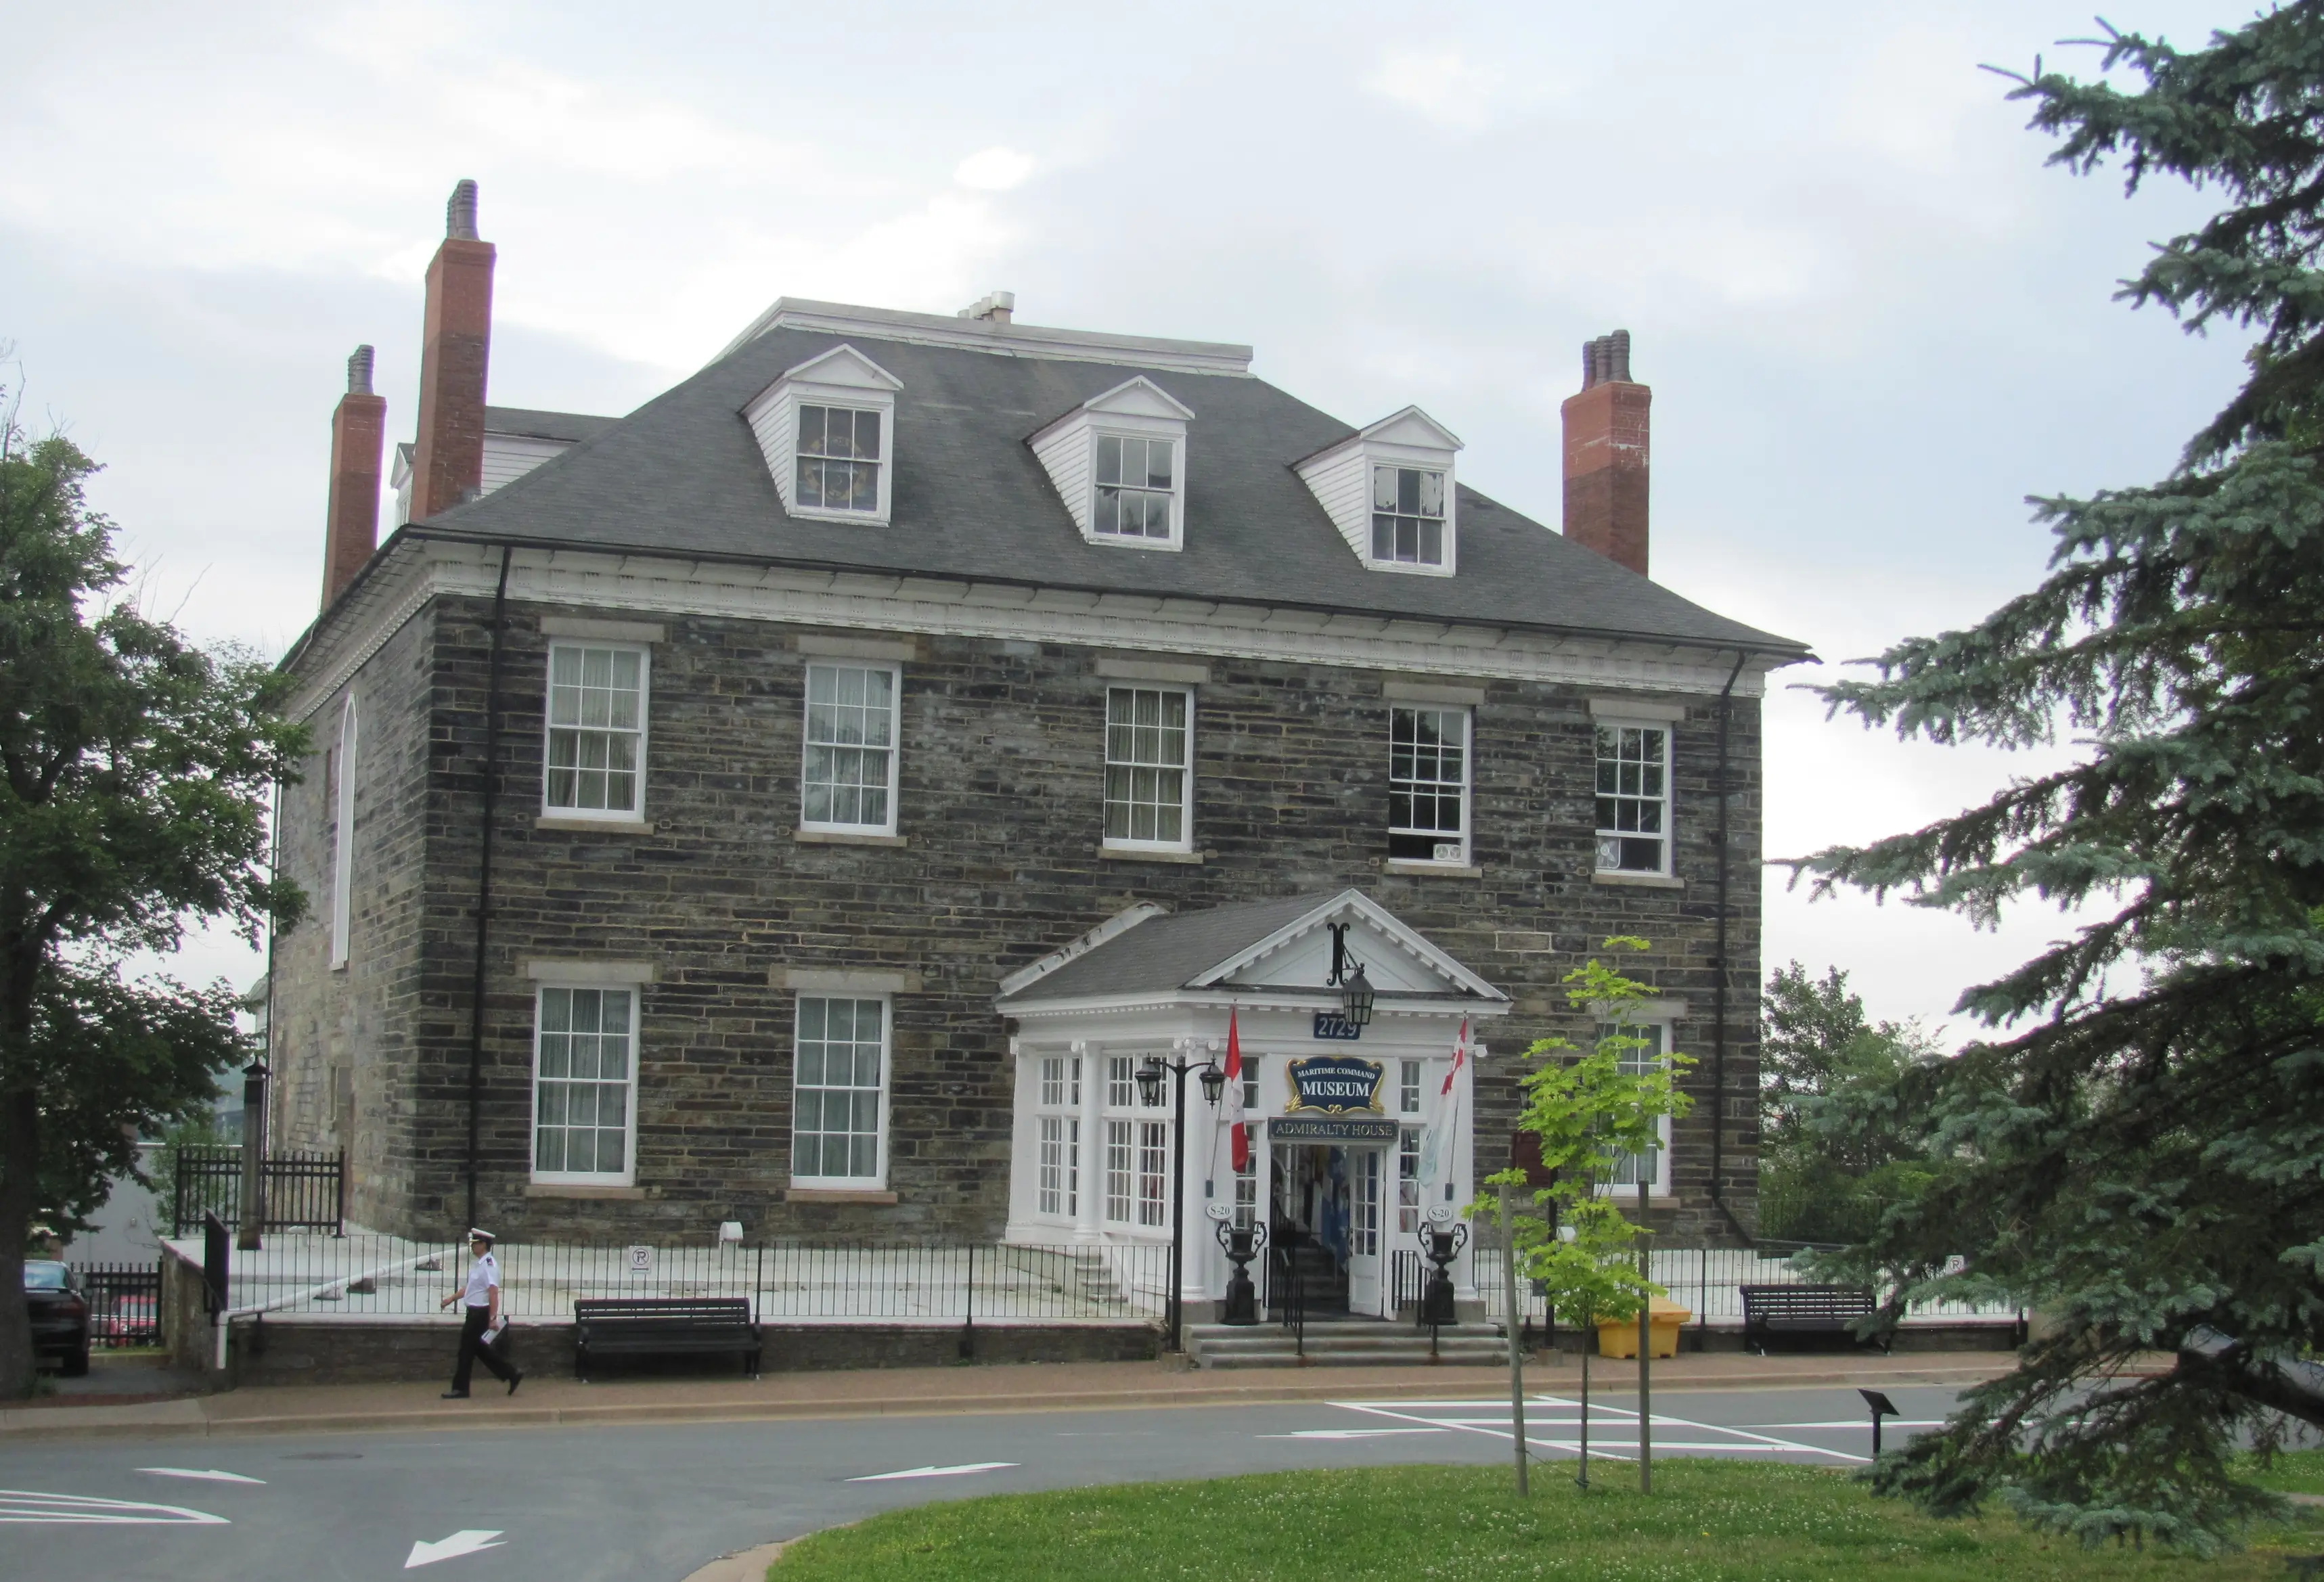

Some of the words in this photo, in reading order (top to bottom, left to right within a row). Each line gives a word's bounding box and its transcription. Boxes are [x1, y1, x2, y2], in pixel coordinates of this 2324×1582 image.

[1318, 1017, 1358, 1036] 2729
[1297, 1066, 1336, 1078] MARITIME
[1337, 1067, 1376, 1080] COMMAND
[1301, 1081, 1370, 1097] MUSEUM
[1276, 1123, 1350, 1135] ADMIRALTY
[1352, 1125, 1393, 1137] HOUSE
[1210, 1206, 1230, 1215] S-20
[1431, 1209, 1450, 1217] S-20
